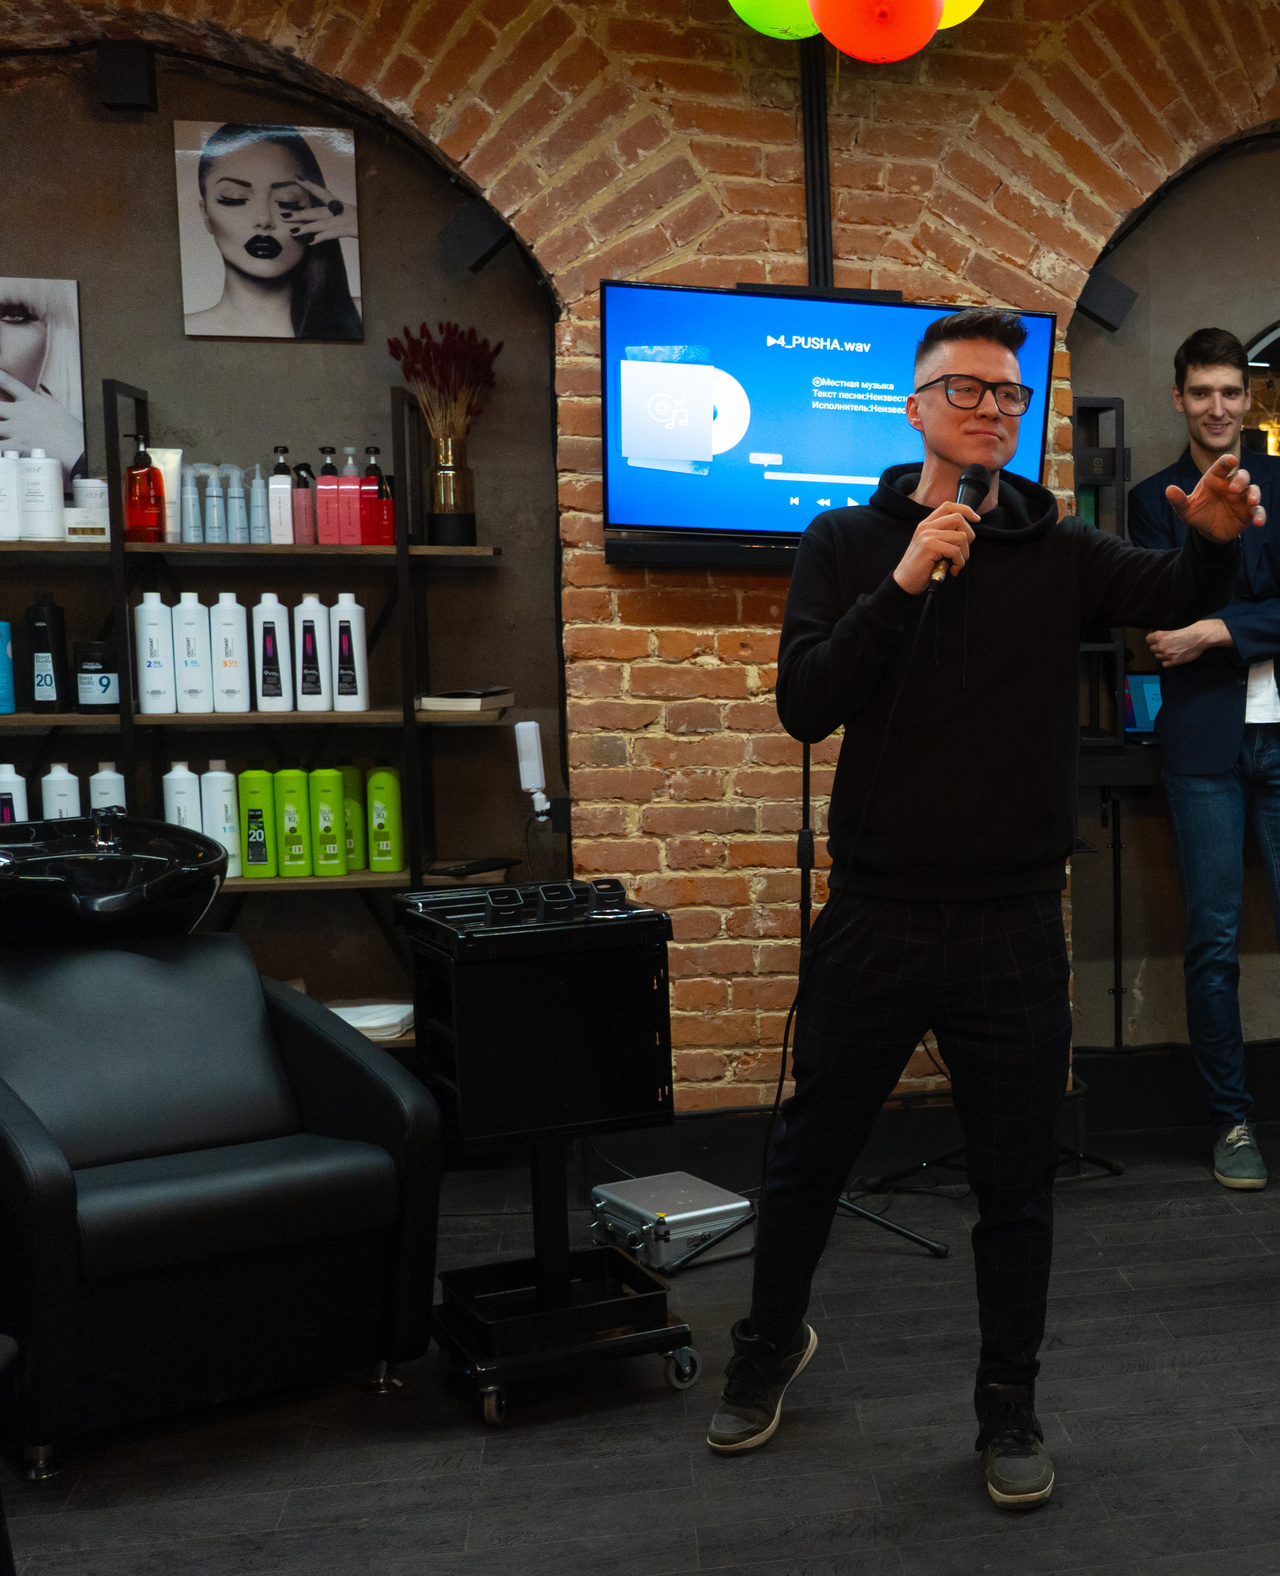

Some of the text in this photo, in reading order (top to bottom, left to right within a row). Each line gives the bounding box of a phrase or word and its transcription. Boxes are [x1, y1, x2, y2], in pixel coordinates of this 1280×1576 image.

[861, 381, 895, 390] музыка
[812, 389, 838, 399] Текст
[222, 660, 228, 668] 3
[36, 674, 53, 687] 20
[98, 675, 111, 694] 9
[248, 830, 265, 842] 20
